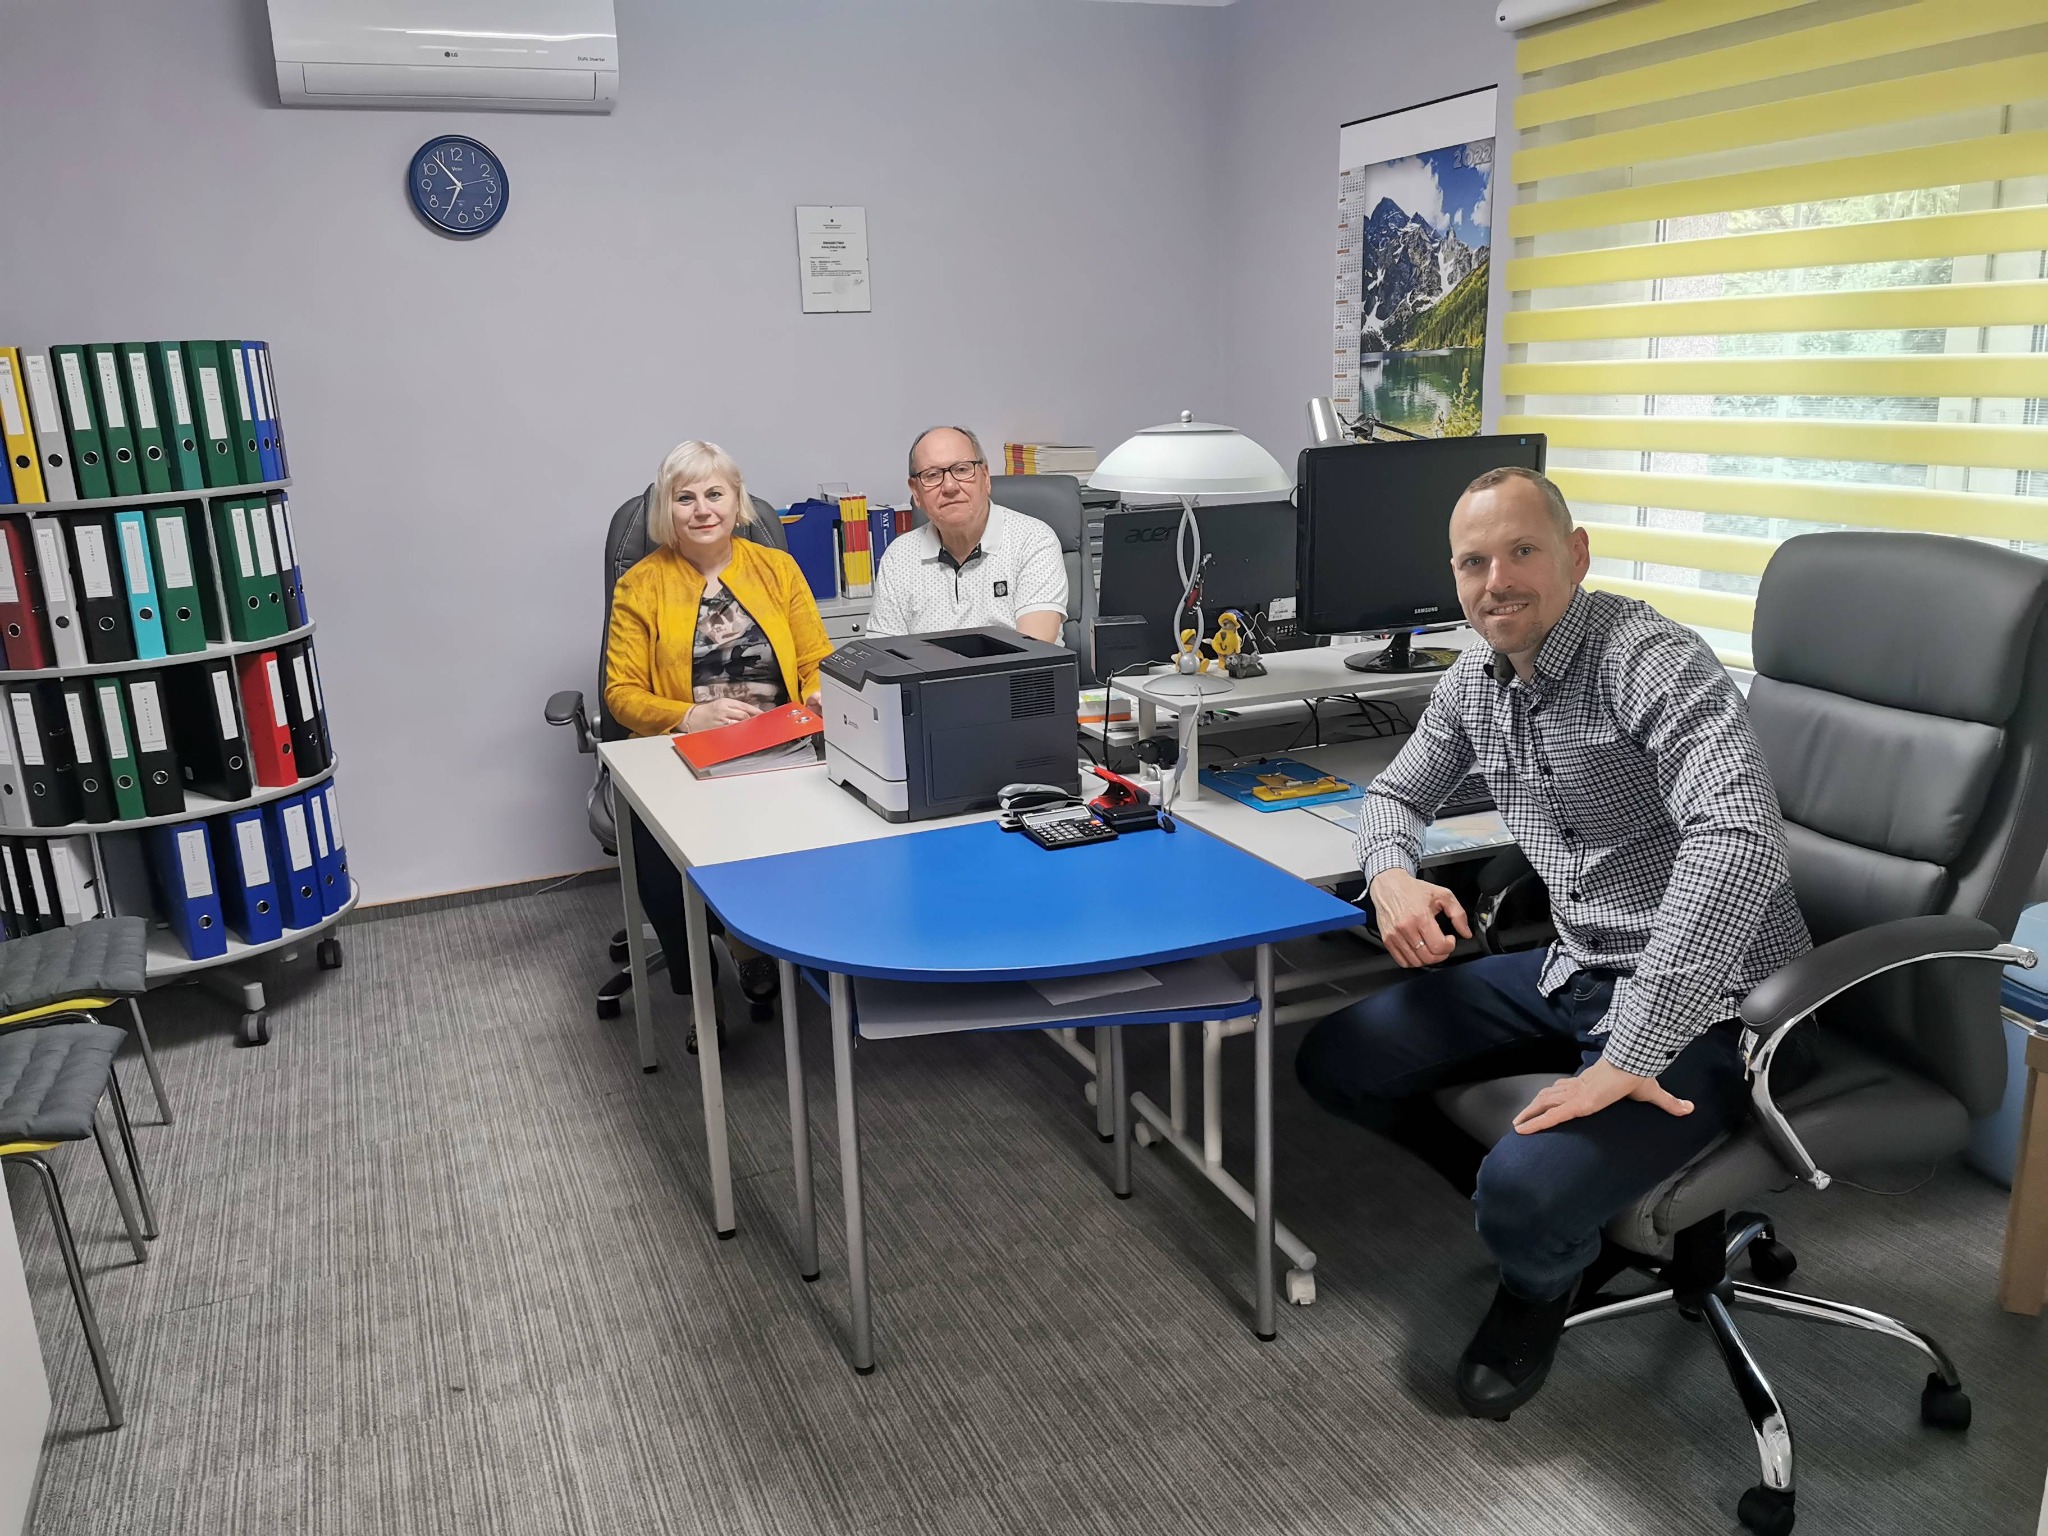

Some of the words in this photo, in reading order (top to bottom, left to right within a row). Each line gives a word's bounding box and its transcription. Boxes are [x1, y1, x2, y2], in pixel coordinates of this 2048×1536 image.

[436, 150, 445, 164] 11
[450, 147, 463, 162] 12
[471, 151, 475, 165] 1
[1453, 144, 1492, 169] 2022
[423, 162, 438, 176] 10
[480, 163, 490, 178] 2
[421, 178, 432, 193] 9
[485, 180, 497, 194] 3
[429, 194, 439, 208] 8
[483, 195, 493, 209] 4
[457, 210, 469, 224] 6
[473, 206, 485, 220] 5
[882, 512, 890, 528] VAT
[1124, 525, 1179, 544] acer
[1414, 606, 1439, 615] SAMSUNG
